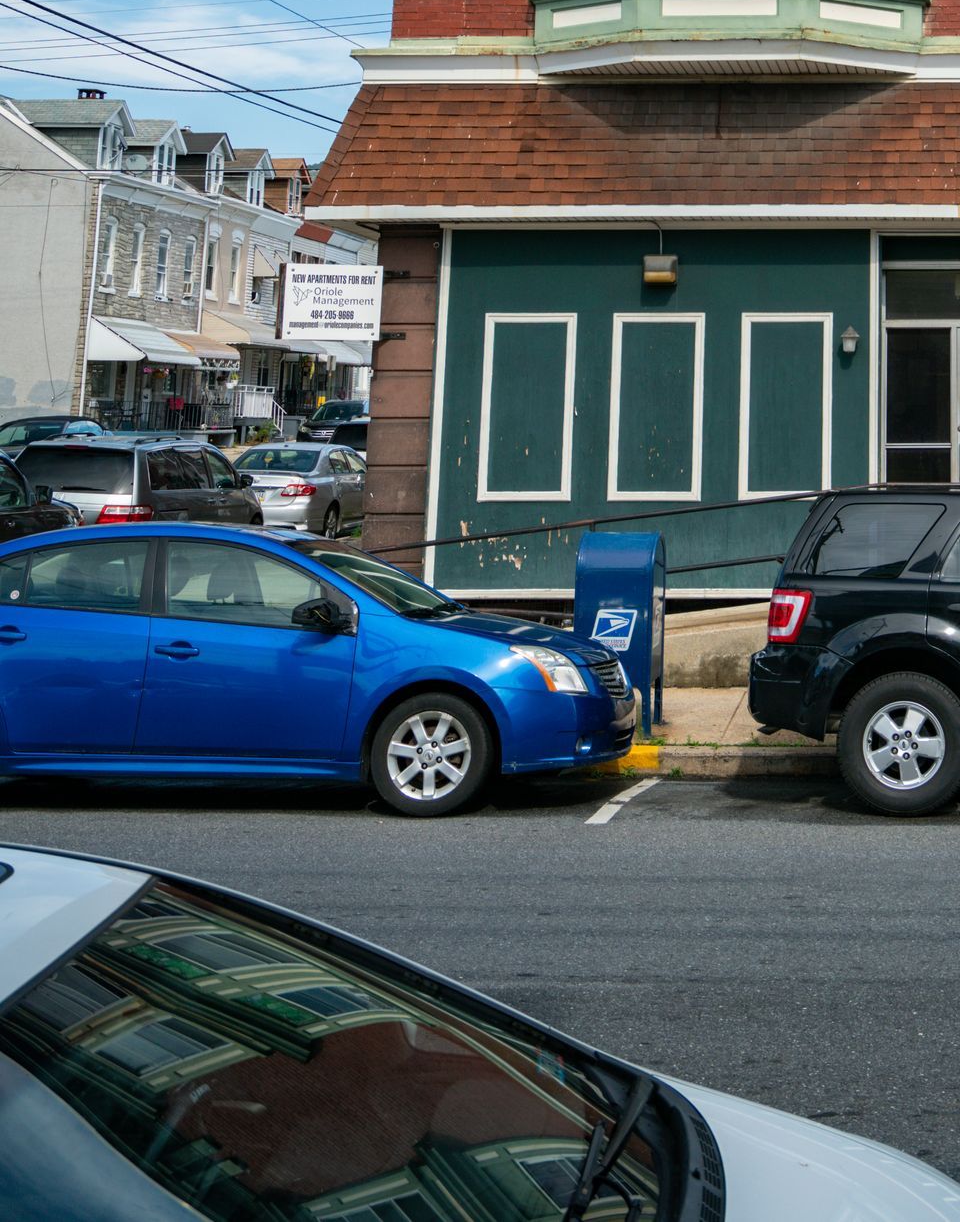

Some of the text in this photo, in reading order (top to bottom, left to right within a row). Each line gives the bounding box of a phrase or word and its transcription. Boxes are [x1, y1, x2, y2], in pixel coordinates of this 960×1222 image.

[291, 274, 377, 285] NEW APARTMENTS FOR RENT
[314, 287, 343, 296] Oriole
[312, 296, 374, 307] Management
